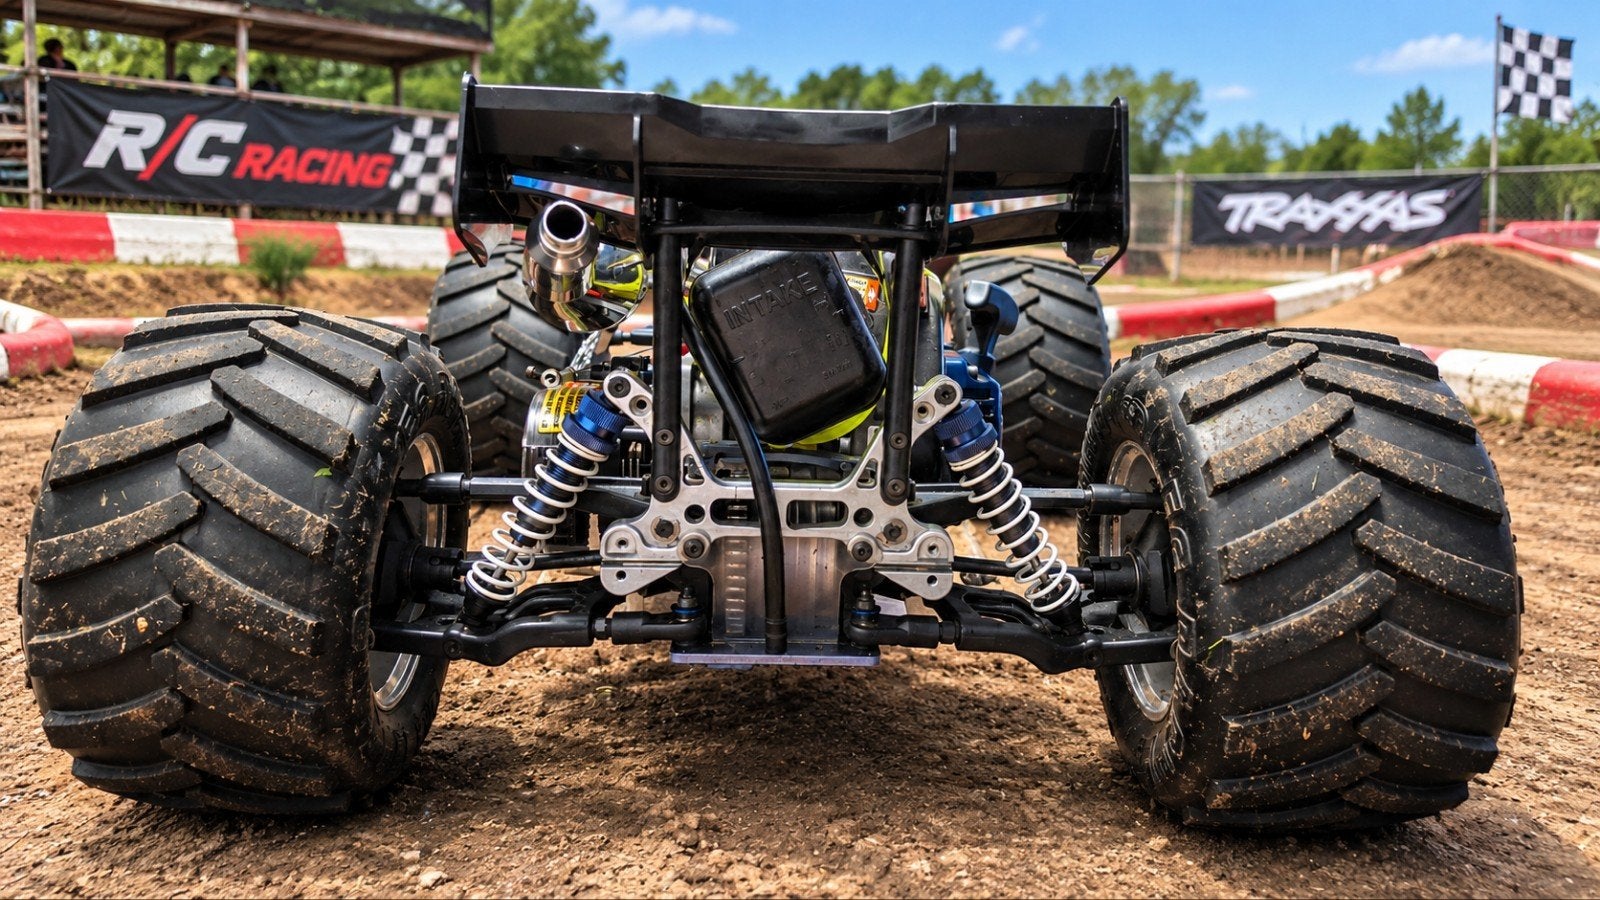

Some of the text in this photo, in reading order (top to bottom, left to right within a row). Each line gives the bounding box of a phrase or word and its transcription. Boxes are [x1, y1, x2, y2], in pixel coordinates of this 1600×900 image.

[83, 109, 395, 189] R/C RACING
[1217, 189, 1449, 234] TRAXXAS
[723, 271, 818, 330] INTAKE
